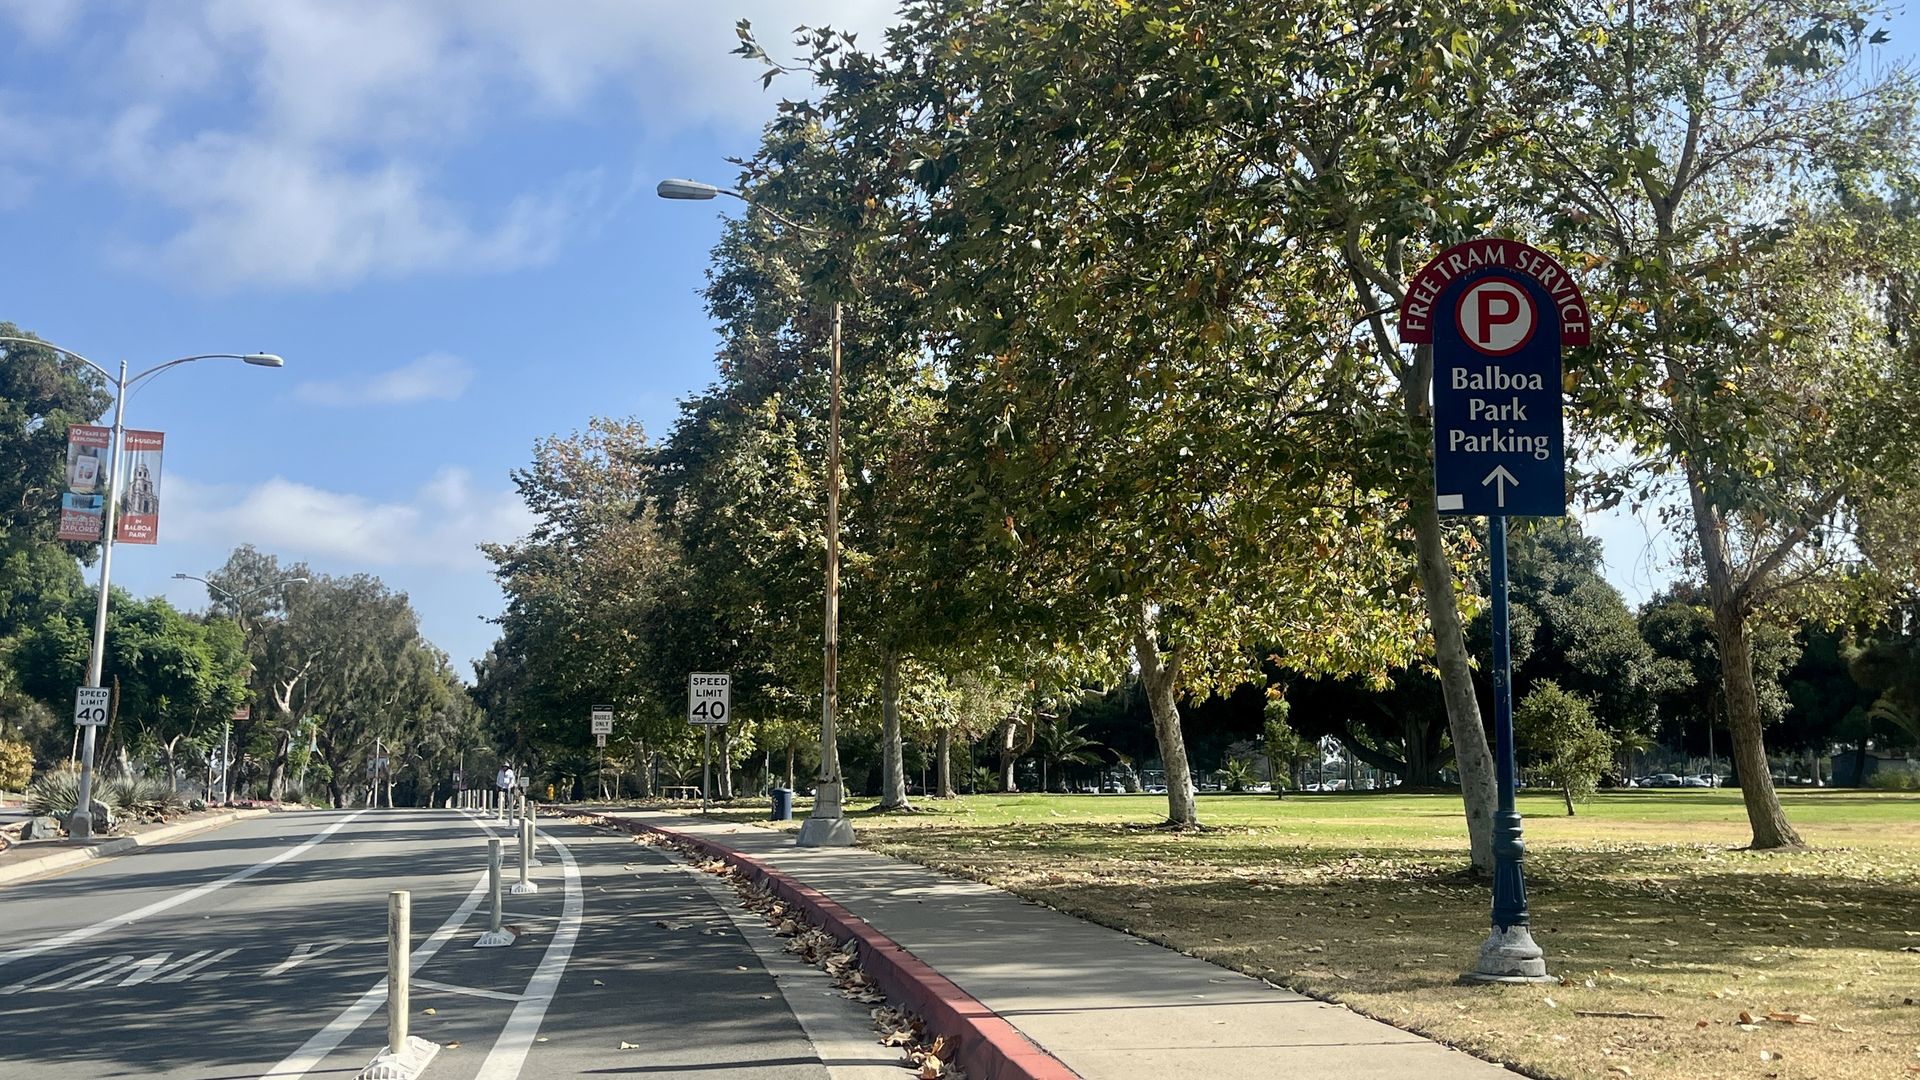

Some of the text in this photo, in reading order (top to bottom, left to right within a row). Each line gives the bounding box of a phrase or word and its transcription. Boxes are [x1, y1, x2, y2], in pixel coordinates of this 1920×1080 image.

[1406, 245, 1584, 333] FREE TRAM SERVICE
[1477, 290, 1520, 344] P
[1452, 365, 1543, 390] Balboa
[1469, 397, 1528, 421] Park
[1449, 429, 1550, 460] Parking
[61, 525, 99, 533] EXPLORER
[124, 524, 151, 532] BALBOA
[693, 677, 727, 685] SPEED
[696, 689, 723, 697] LIMIT
[77, 708, 105, 722] 40
[692, 701, 725, 719] 40
